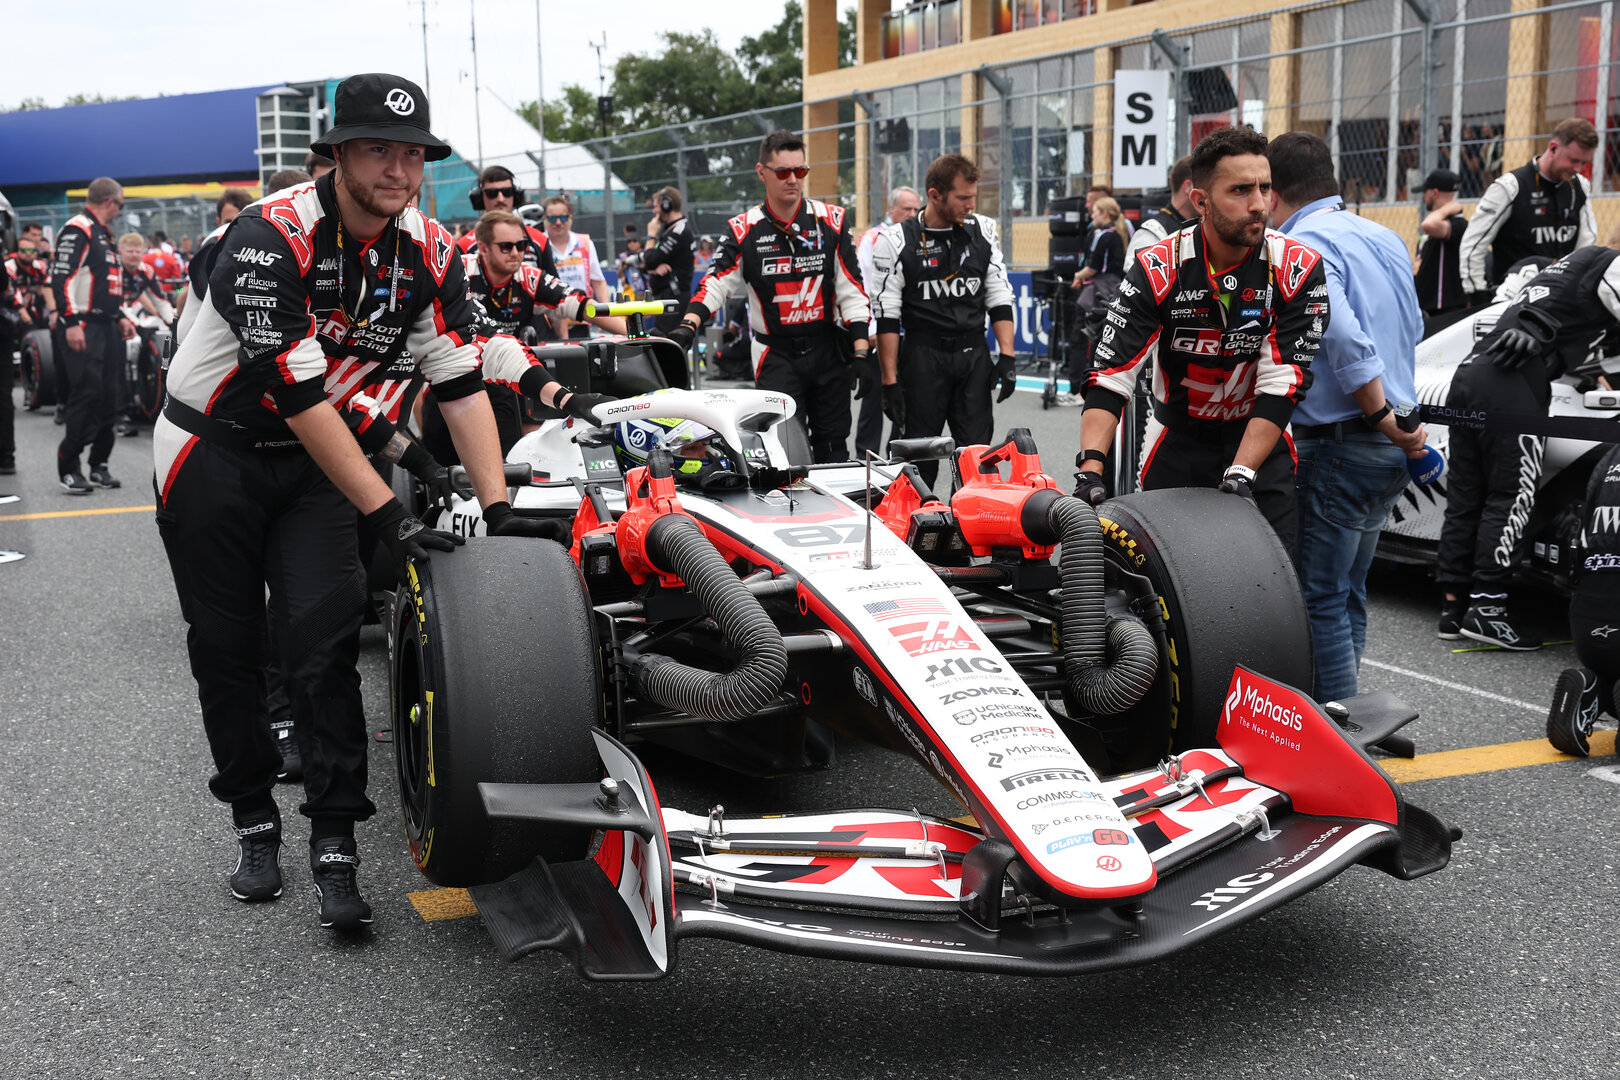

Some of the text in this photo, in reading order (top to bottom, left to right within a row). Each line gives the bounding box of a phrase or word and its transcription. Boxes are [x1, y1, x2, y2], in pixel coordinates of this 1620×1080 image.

[756, 234, 777, 243] HAAS
[233, 247, 282, 266] HAAS
[795, 253, 826, 262] TOYOTA
[795, 260, 823, 268] GAZOO
[763, 263, 791, 274] GR
[248, 278, 278, 288] RUCKUS
[918, 278, 966, 300] TWG
[235, 294, 278, 308] PIRELLI
[1175, 289, 1209, 302] HAAS
[246, 310, 272, 327] FIX
[780, 306, 825, 323] HAAS
[249, 328, 282, 338] UChicago
[250, 336, 282, 345] Medicine
[353, 329, 395, 344] GAZOO
[1172, 337, 1220, 355] GR
[607, 402, 651, 415] ORION180
[1188, 397, 1260, 421] HAAS
[1429, 406, 1488, 421] CADILLAC
[453, 513, 480, 537] FIX
[773, 524, 868, 548] 87
[846, 581, 922, 593] ZANARDI
[909, 640, 978, 655] HAAS
[930, 680, 950, 688] Your
[939, 686, 1025, 705] ZOOMEX
[975, 703, 1037, 713] UChicago
[980, 711, 1043, 720] Medicine
[1243, 685, 1303, 731] Mphasis
[970, 726, 1055, 743] ORION180
[975, 733, 1056, 748] INSURANCE
[1240, 716, 1301, 751] The Next Applied
[1005, 744, 1071, 755] Mphasis
[1000, 768, 1091, 792] PIRELLI
[1017, 790, 1107, 810] COMMSCOPE
[1051, 830, 1129, 852] PLAY'n GO
[1275, 825, 1343, 869] Trading Edge
[1256, 856, 1286, 870] Your
[920, 938, 967, 947] Edge
